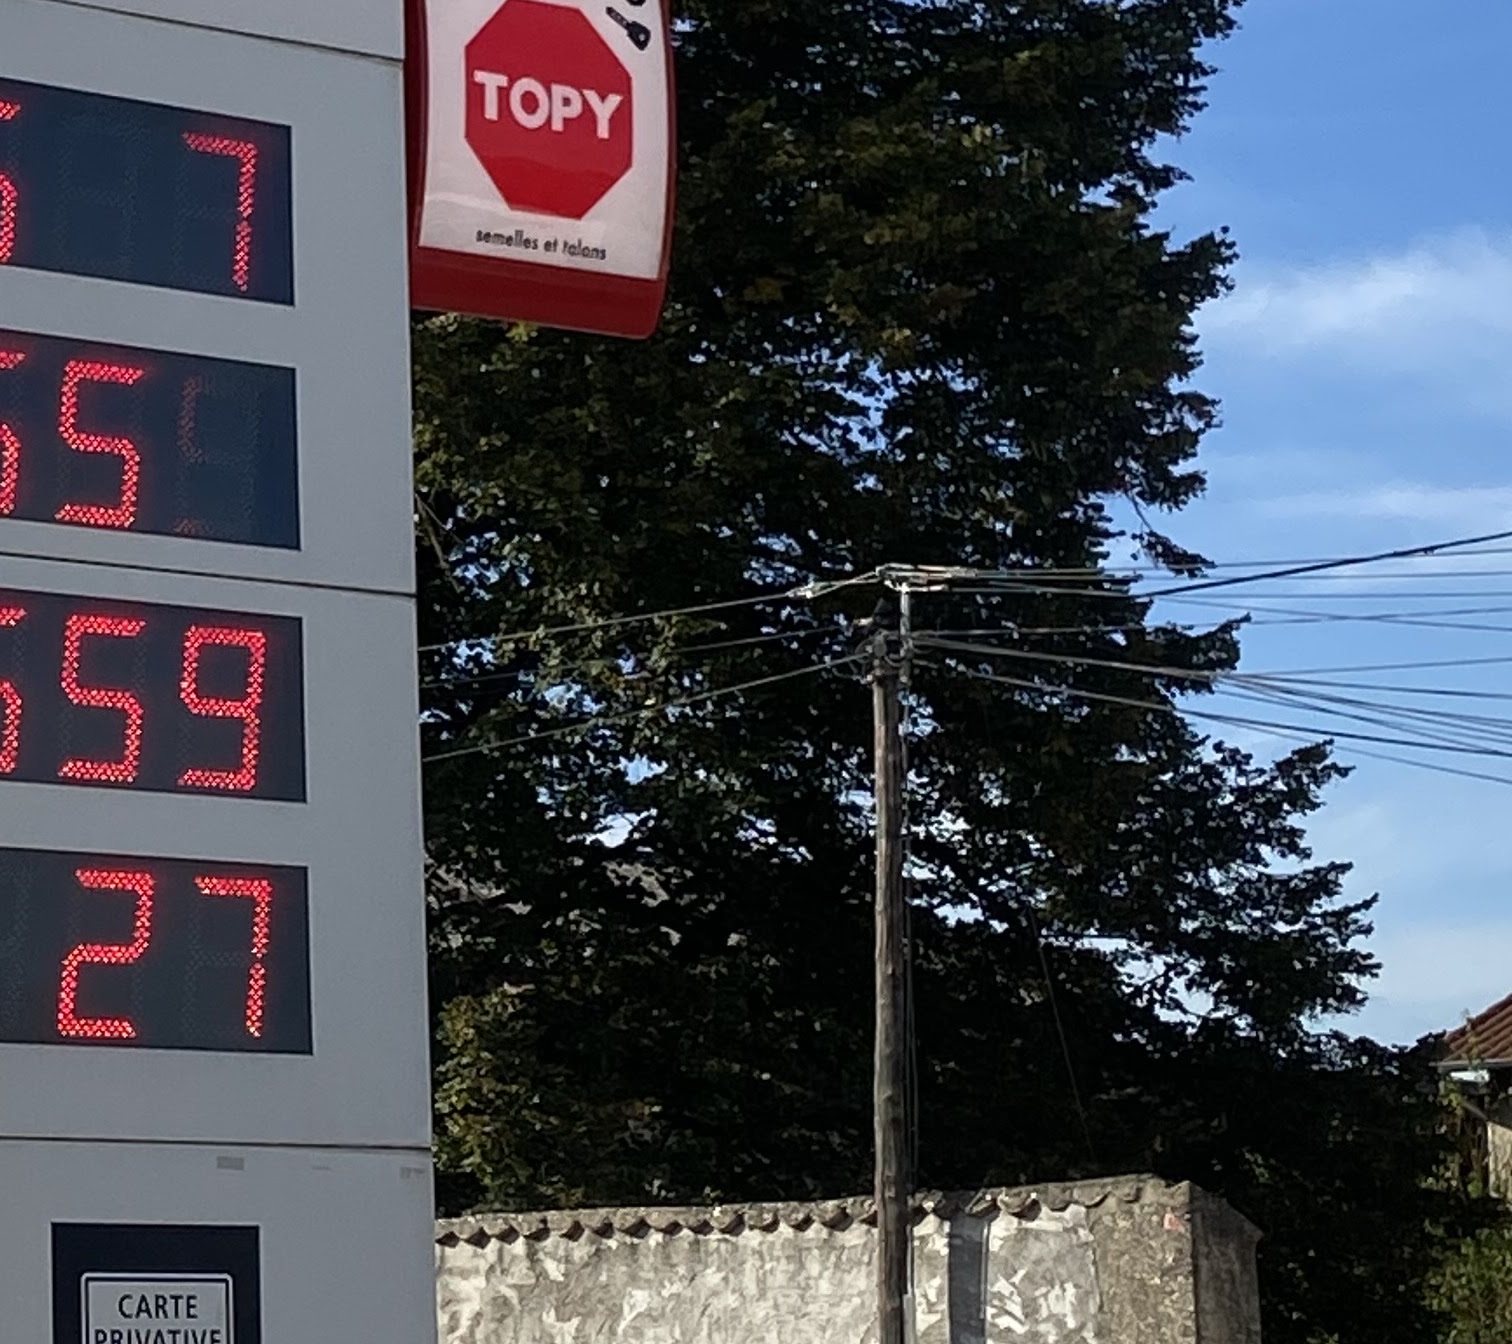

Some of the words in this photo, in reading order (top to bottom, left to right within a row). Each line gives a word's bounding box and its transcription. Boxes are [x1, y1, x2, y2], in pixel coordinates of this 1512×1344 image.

[472, 69, 624, 140] TOPY
[476, 229, 538, 250] semelles
[543, 238, 558, 252] et
[562, 238, 606, 260] talons
[118, 1294, 198, 1319] CARTE
